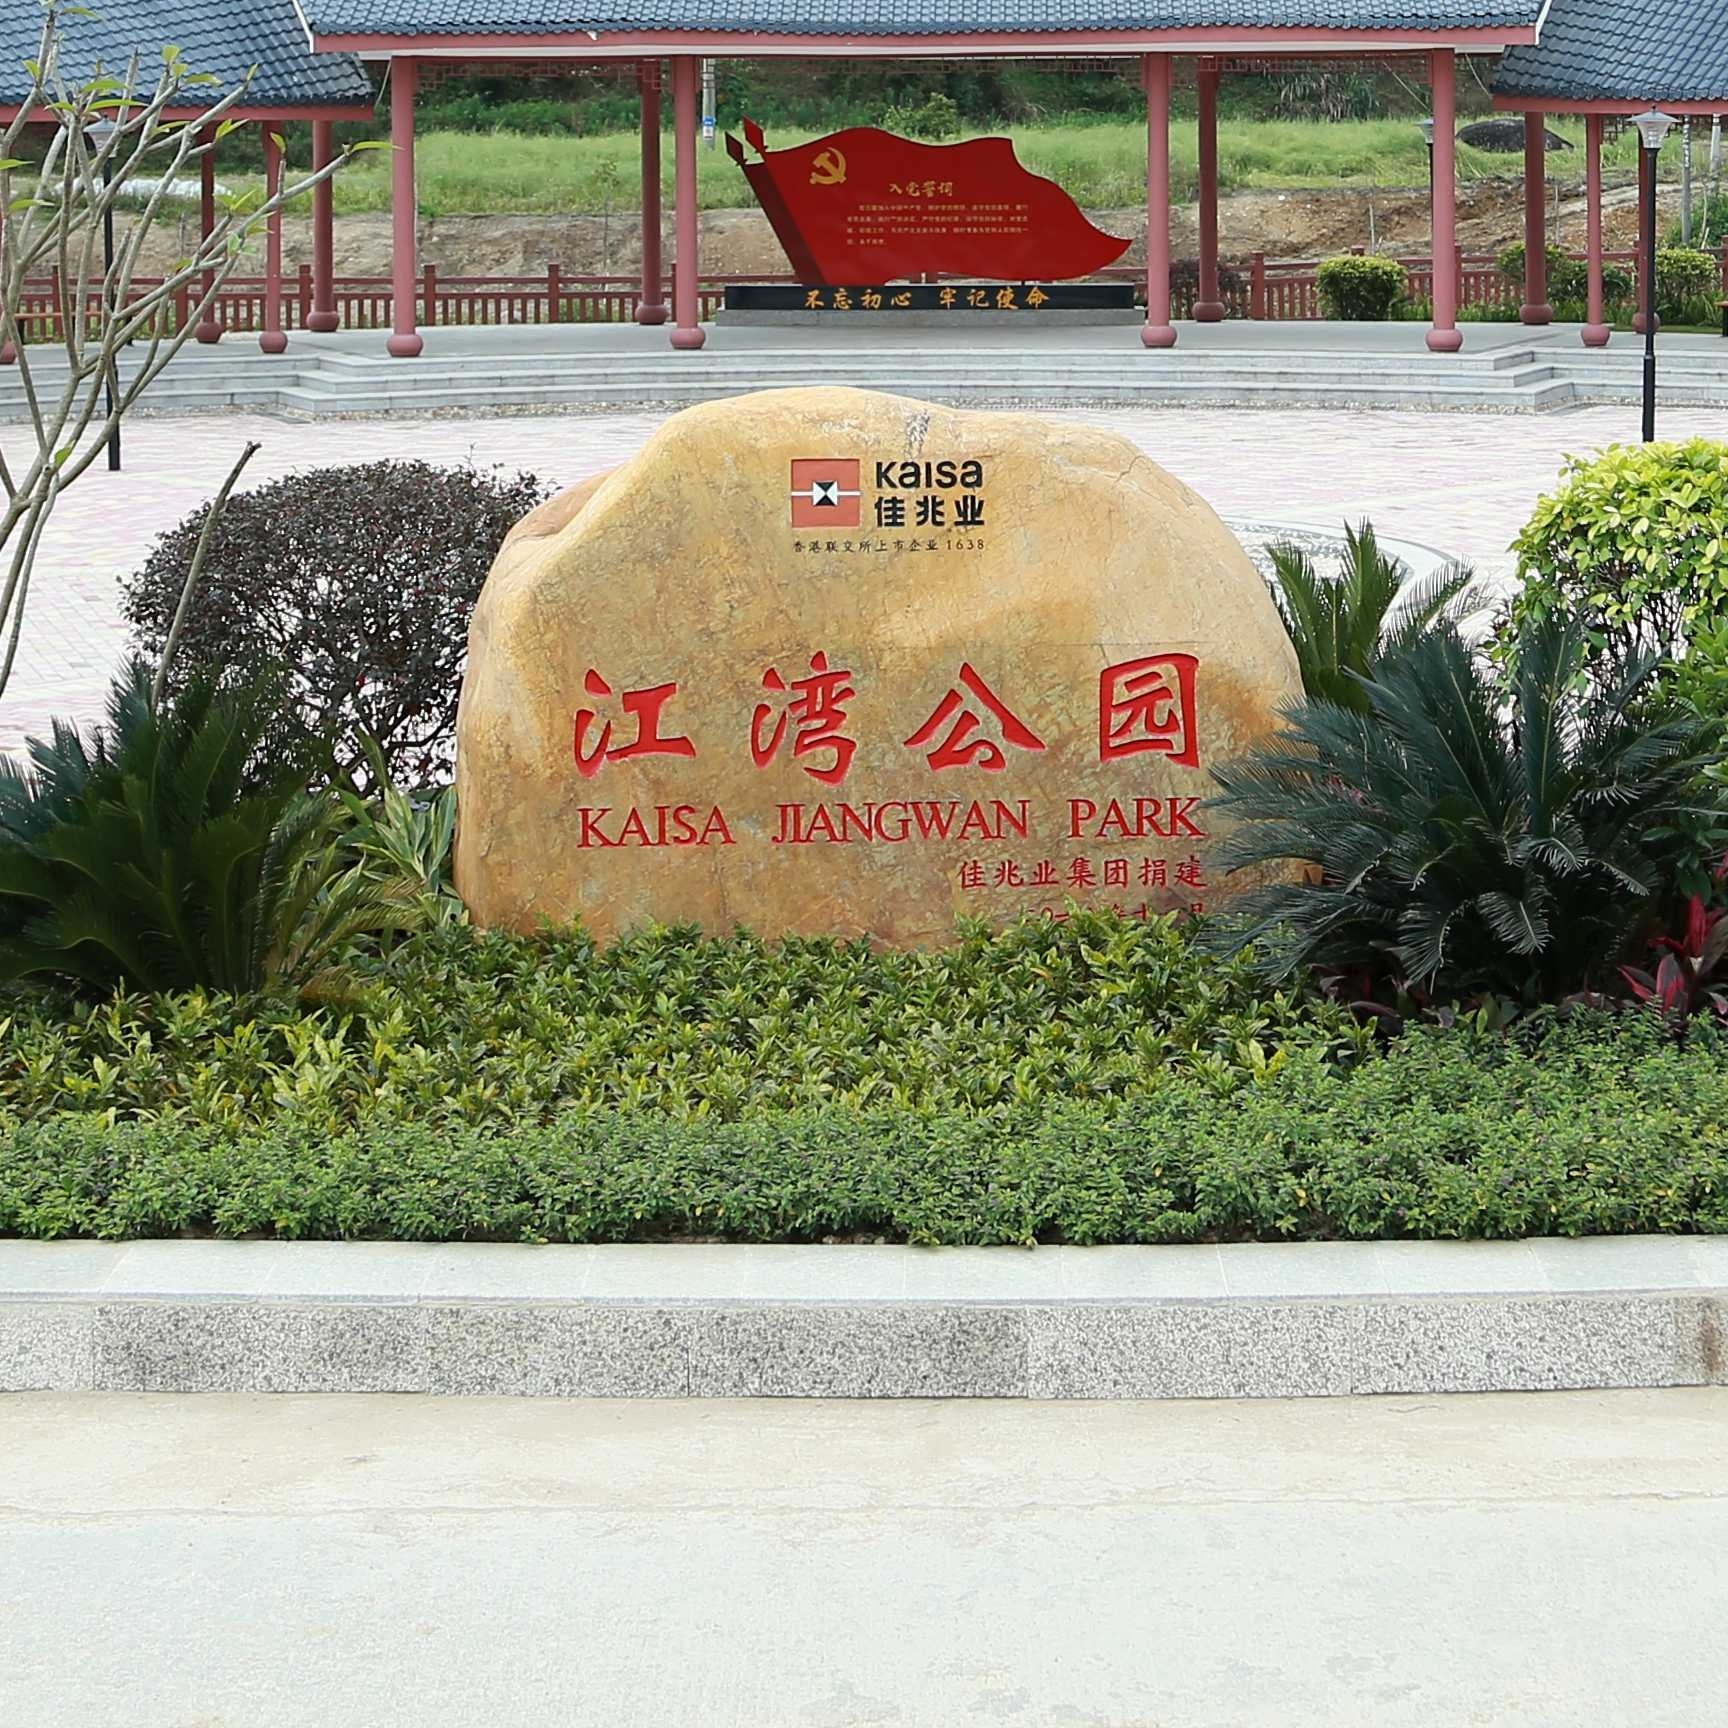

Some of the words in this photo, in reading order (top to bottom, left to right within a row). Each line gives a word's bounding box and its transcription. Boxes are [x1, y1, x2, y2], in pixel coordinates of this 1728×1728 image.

[804, 288, 912, 310] 不忘初心
[939, 287, 1050, 310] 牢记使命
[874, 494, 985, 527] 佳兆业
[792, 539, 939, 553] 香港联交所上市企业
[946, 538, 985, 551] 1638
[573, 650, 1202, 786] 江湾公园
[577, 804, 737, 850] KAISA
[771, 798, 1032, 846] JIANGWAN
[1067, 796, 1205, 840] PARK
[958, 855, 1208, 890] 佳兆业集团捐建
